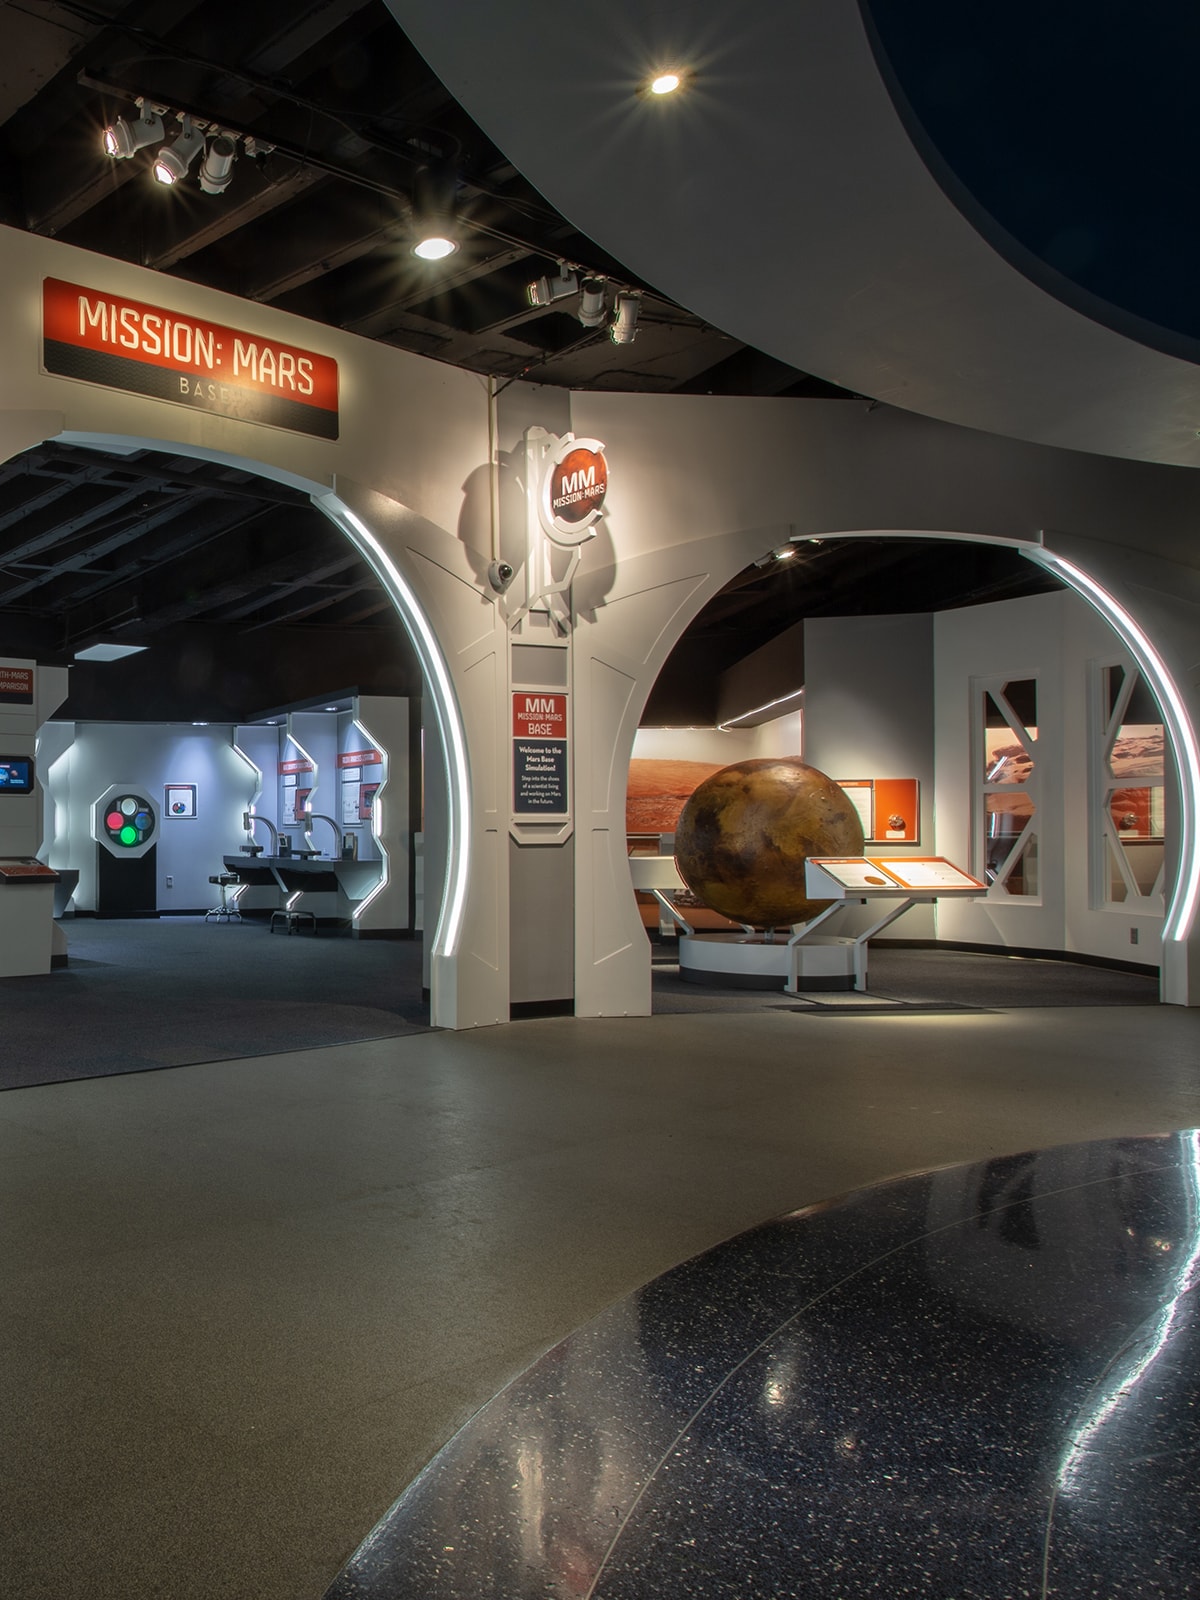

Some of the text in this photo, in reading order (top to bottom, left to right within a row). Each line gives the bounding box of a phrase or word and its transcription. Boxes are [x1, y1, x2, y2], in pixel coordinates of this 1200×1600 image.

[78, 295, 314, 396] MISSION: MARS
[180, 377, 230, 404] BASE
[562, 466, 595, 496] MM
[526, 698, 555, 713] MM
[528, 723, 552, 735] BASE
